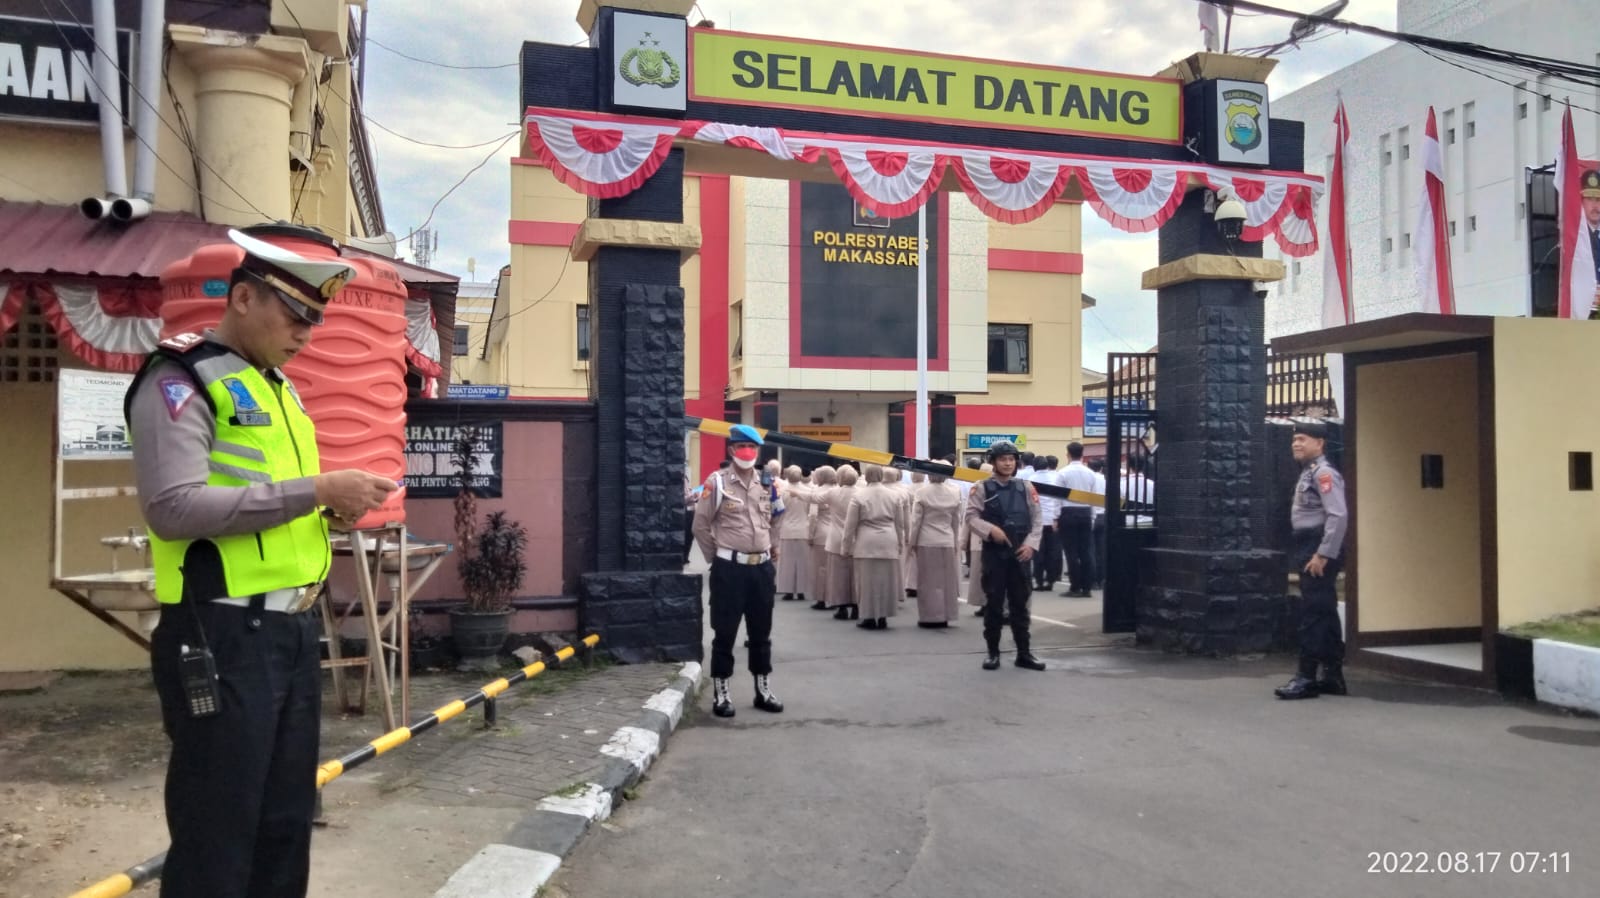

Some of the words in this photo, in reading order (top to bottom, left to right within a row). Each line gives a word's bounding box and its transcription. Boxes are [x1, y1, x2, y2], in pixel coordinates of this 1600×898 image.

[732, 50, 956, 105] SELAMAT
[974, 75, 1150, 126] DATANG
[824, 248, 919, 266] MAKASSAR
[414, 442, 454, 452] ONLINE
[421, 477, 447, 487] PINTU
